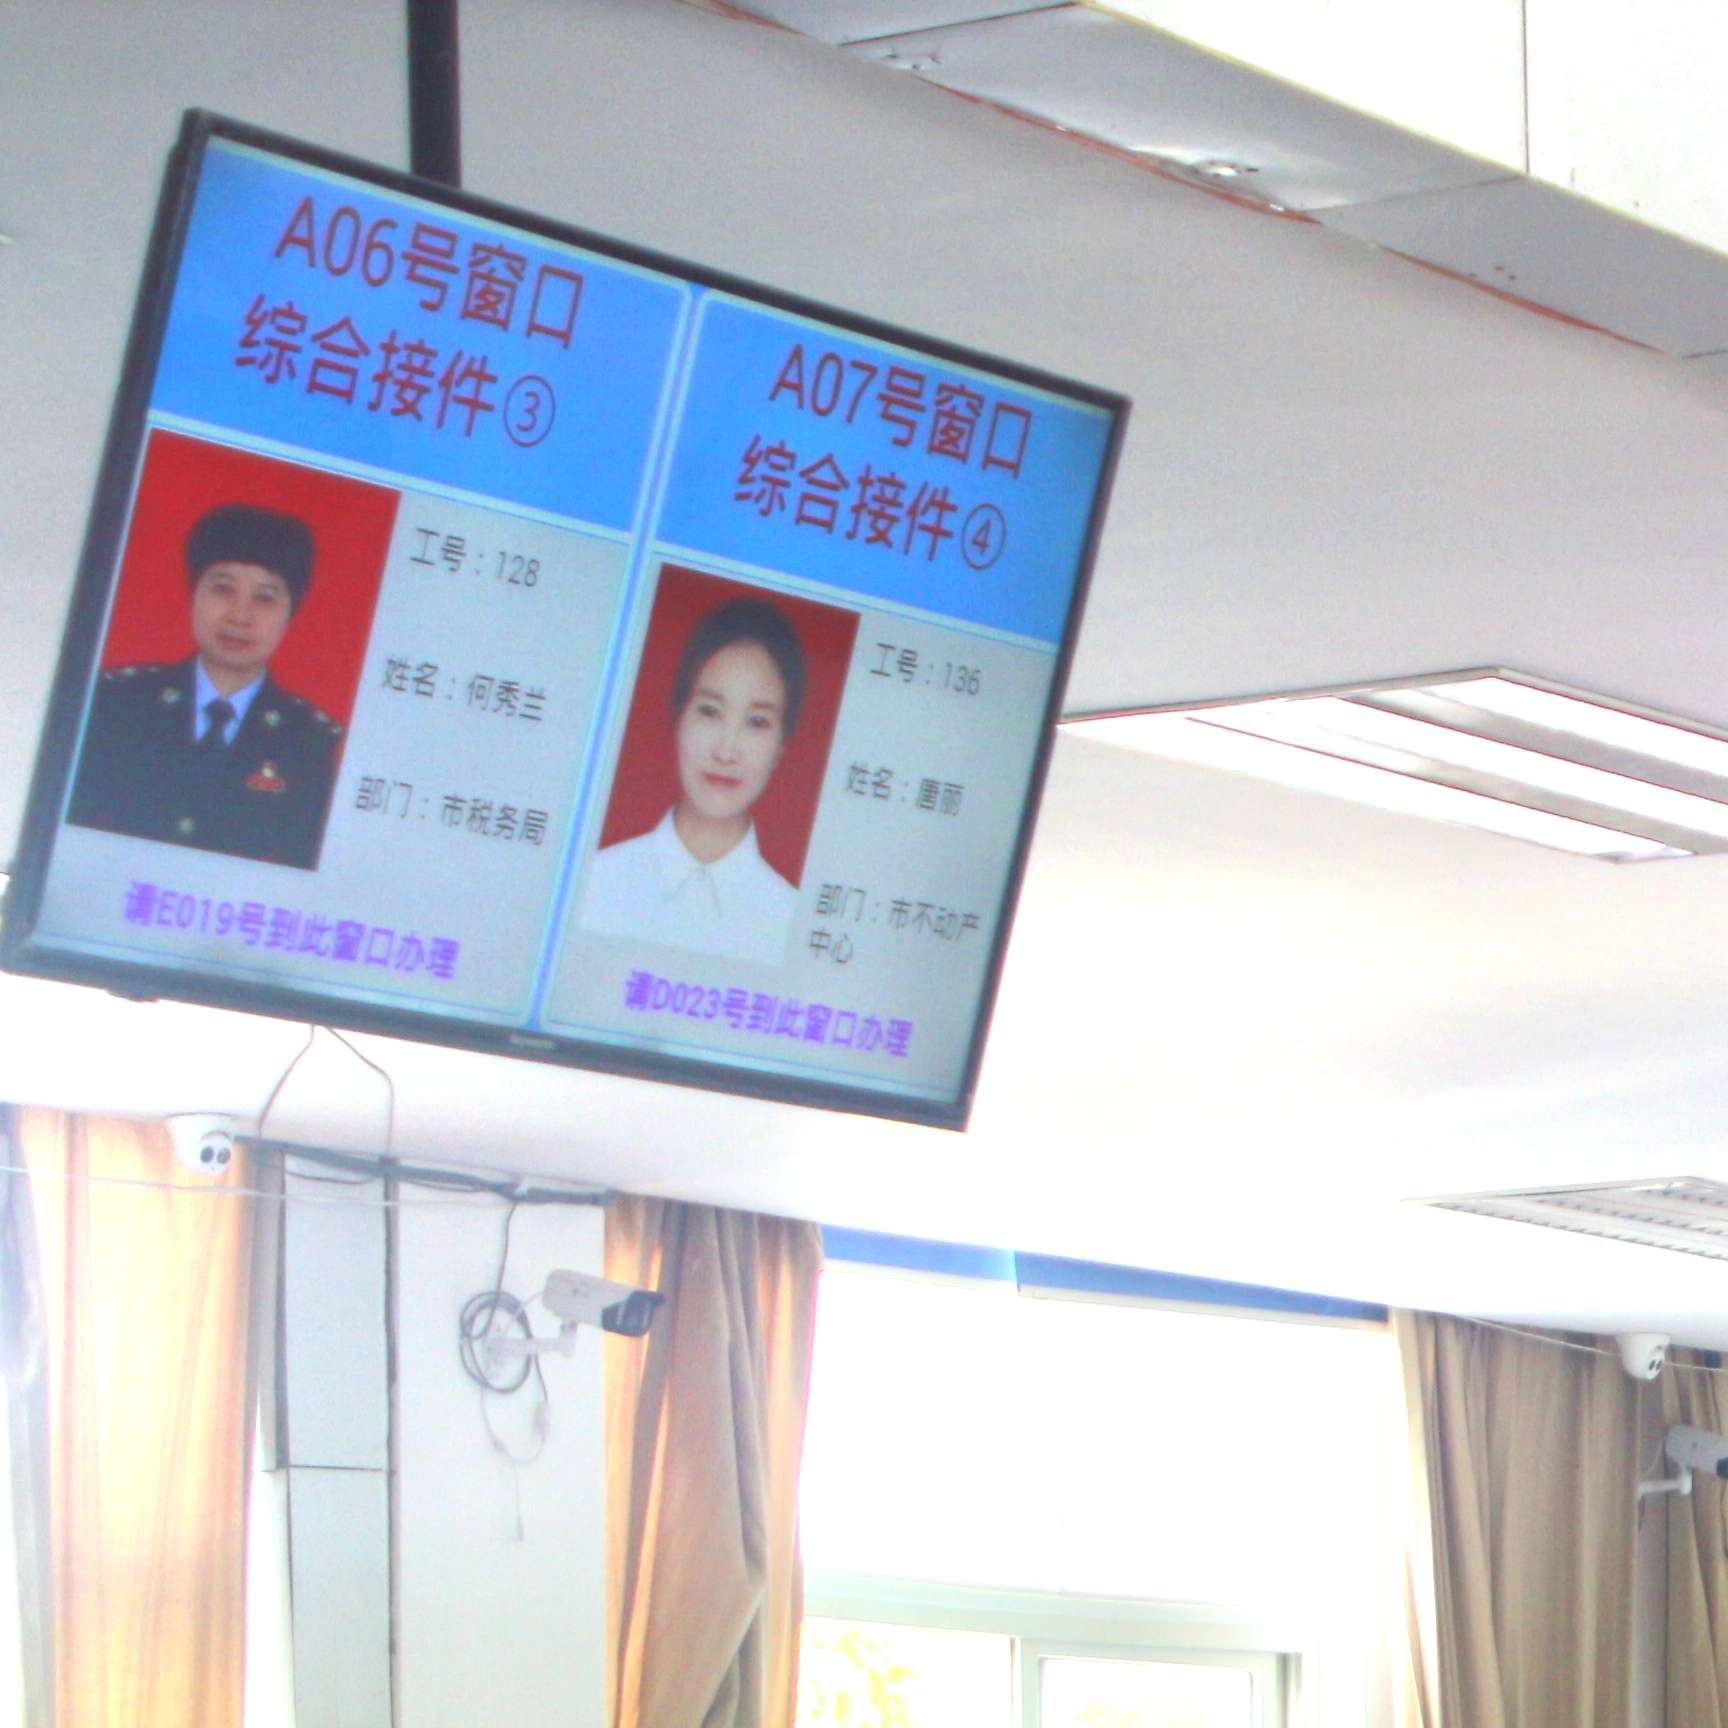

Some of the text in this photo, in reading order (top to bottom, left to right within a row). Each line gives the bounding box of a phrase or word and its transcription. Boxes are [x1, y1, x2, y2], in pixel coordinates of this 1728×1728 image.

[273, 196, 584, 350] A06号窗口
[768, 343, 1033, 480] A07号窗口
